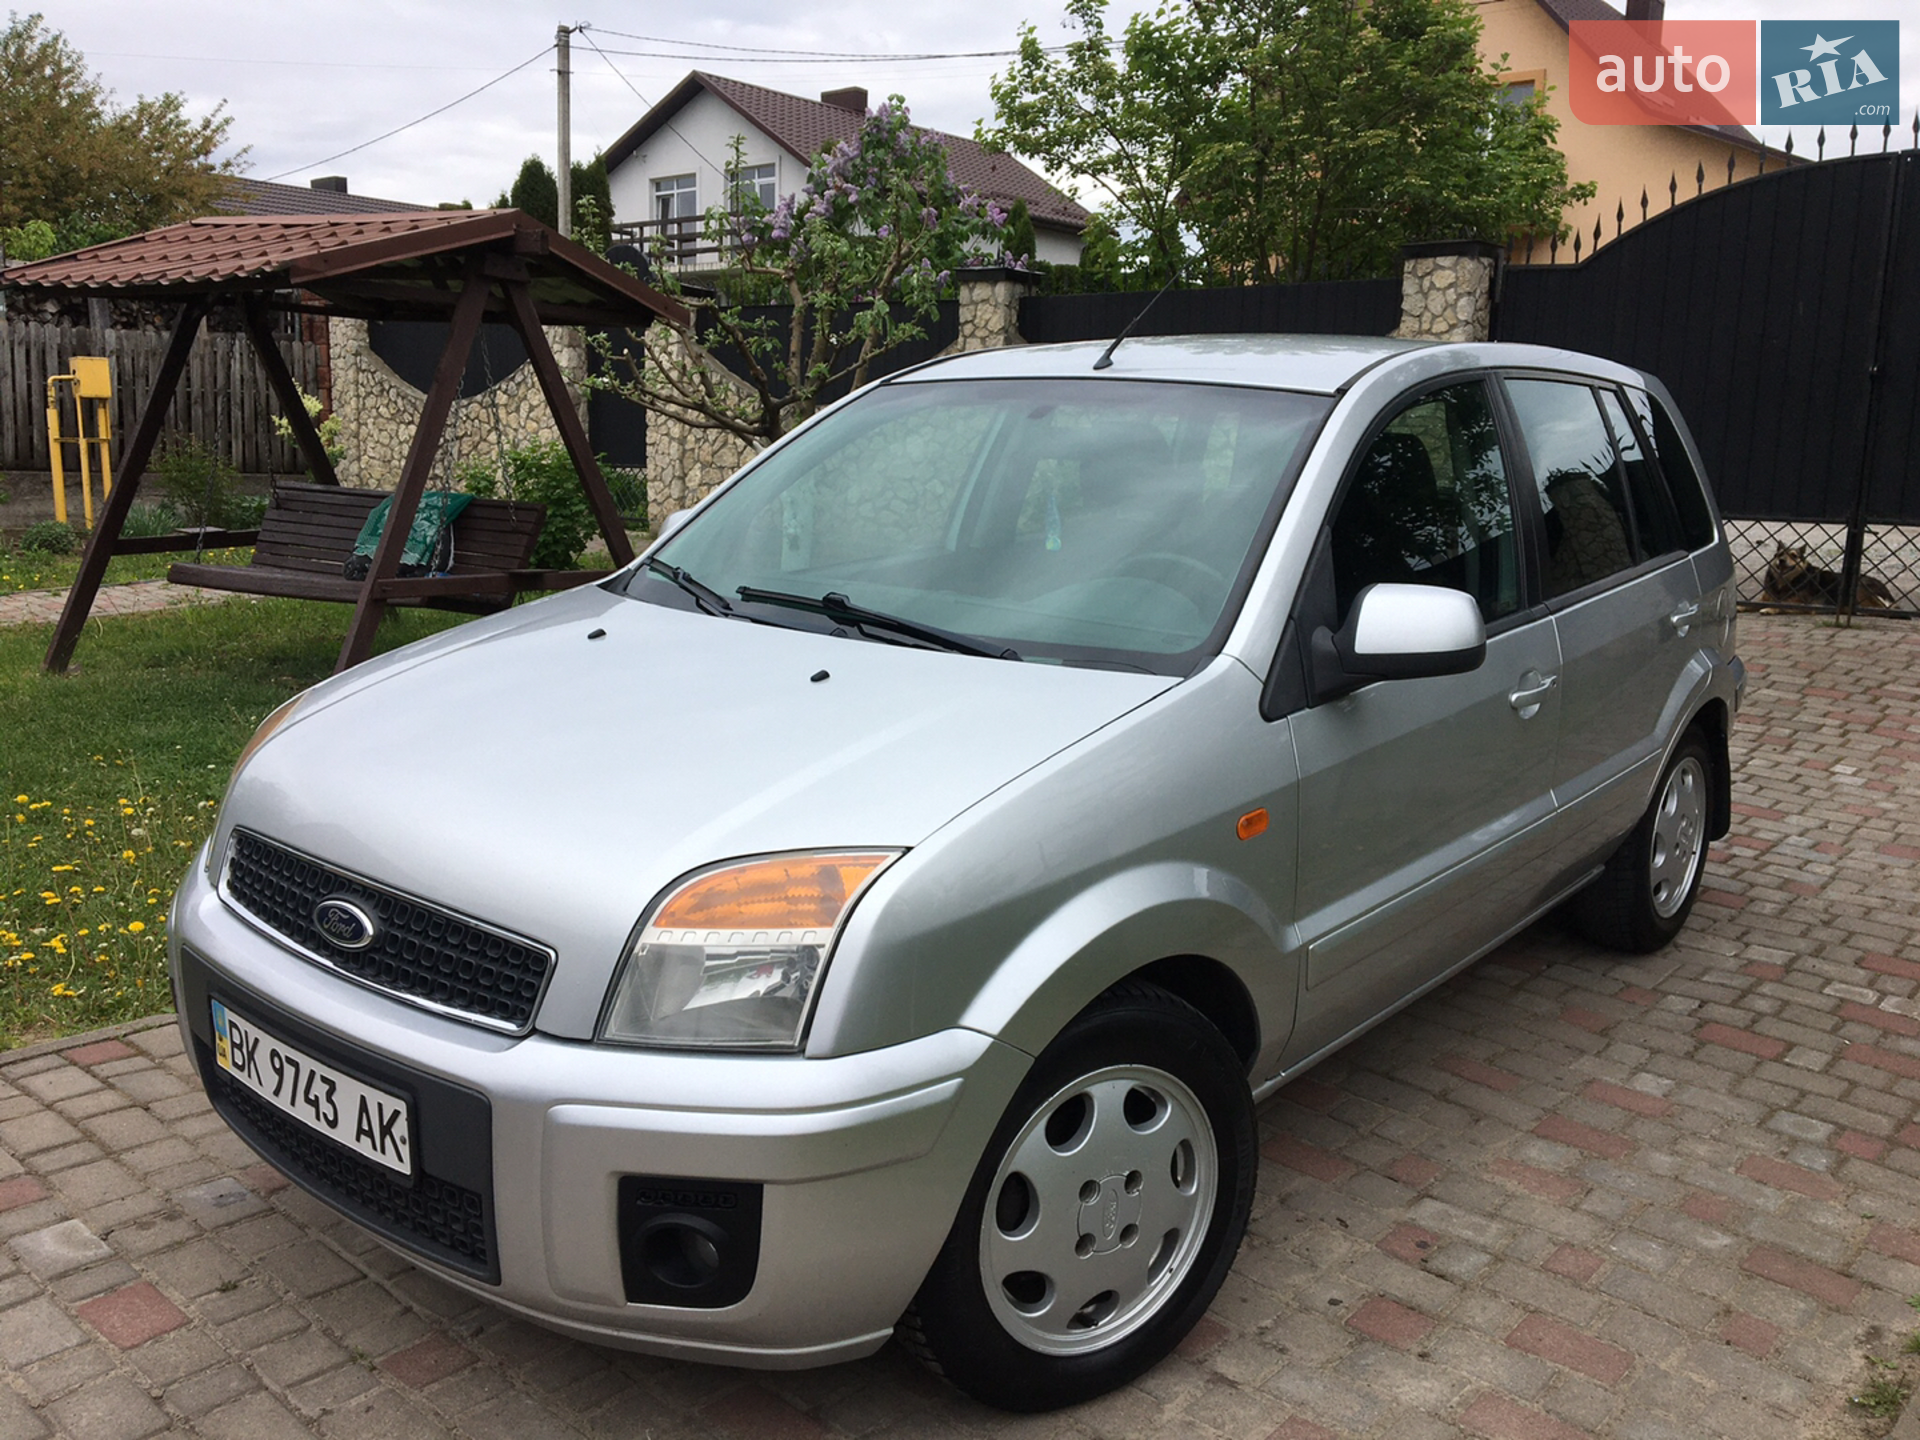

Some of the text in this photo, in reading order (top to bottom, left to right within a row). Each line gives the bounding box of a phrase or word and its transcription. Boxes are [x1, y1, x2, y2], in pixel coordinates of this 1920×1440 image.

[323, 908, 356, 938] Ford
[228, 1019, 405, 1164] BK 9743 AK
